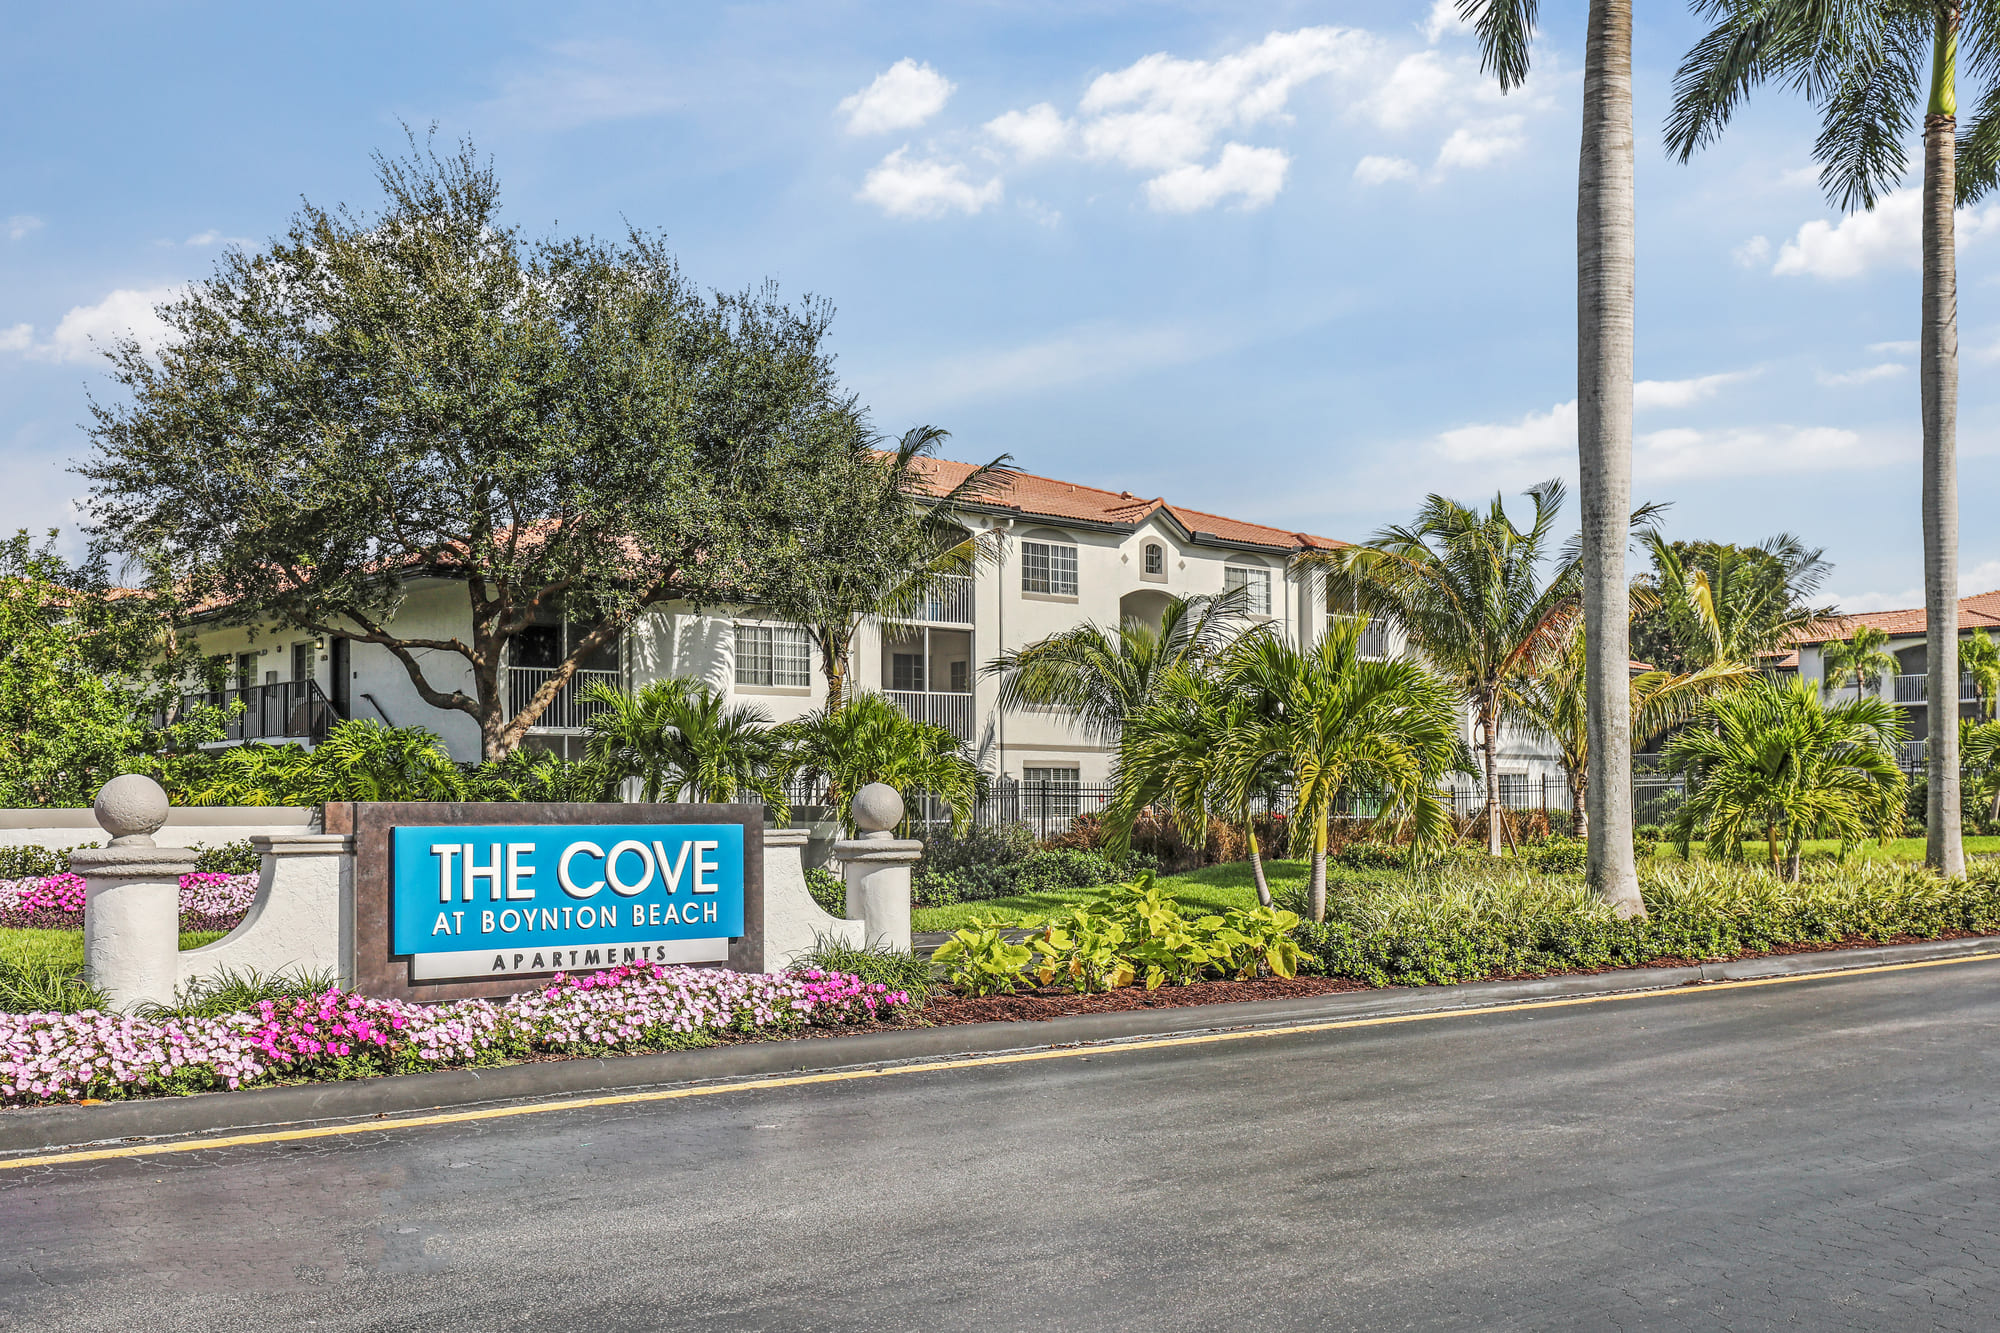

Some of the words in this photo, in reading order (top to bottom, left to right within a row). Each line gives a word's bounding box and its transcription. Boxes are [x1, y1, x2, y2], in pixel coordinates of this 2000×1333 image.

[430, 843, 536, 901] THE
[557, 840, 719, 898] COVE
[432, 911, 464, 936] AT
[481, 905, 617, 933] BOYNTON
[632, 901, 718, 927] BEACH
[492, 945, 666, 971] APARTMENTS
